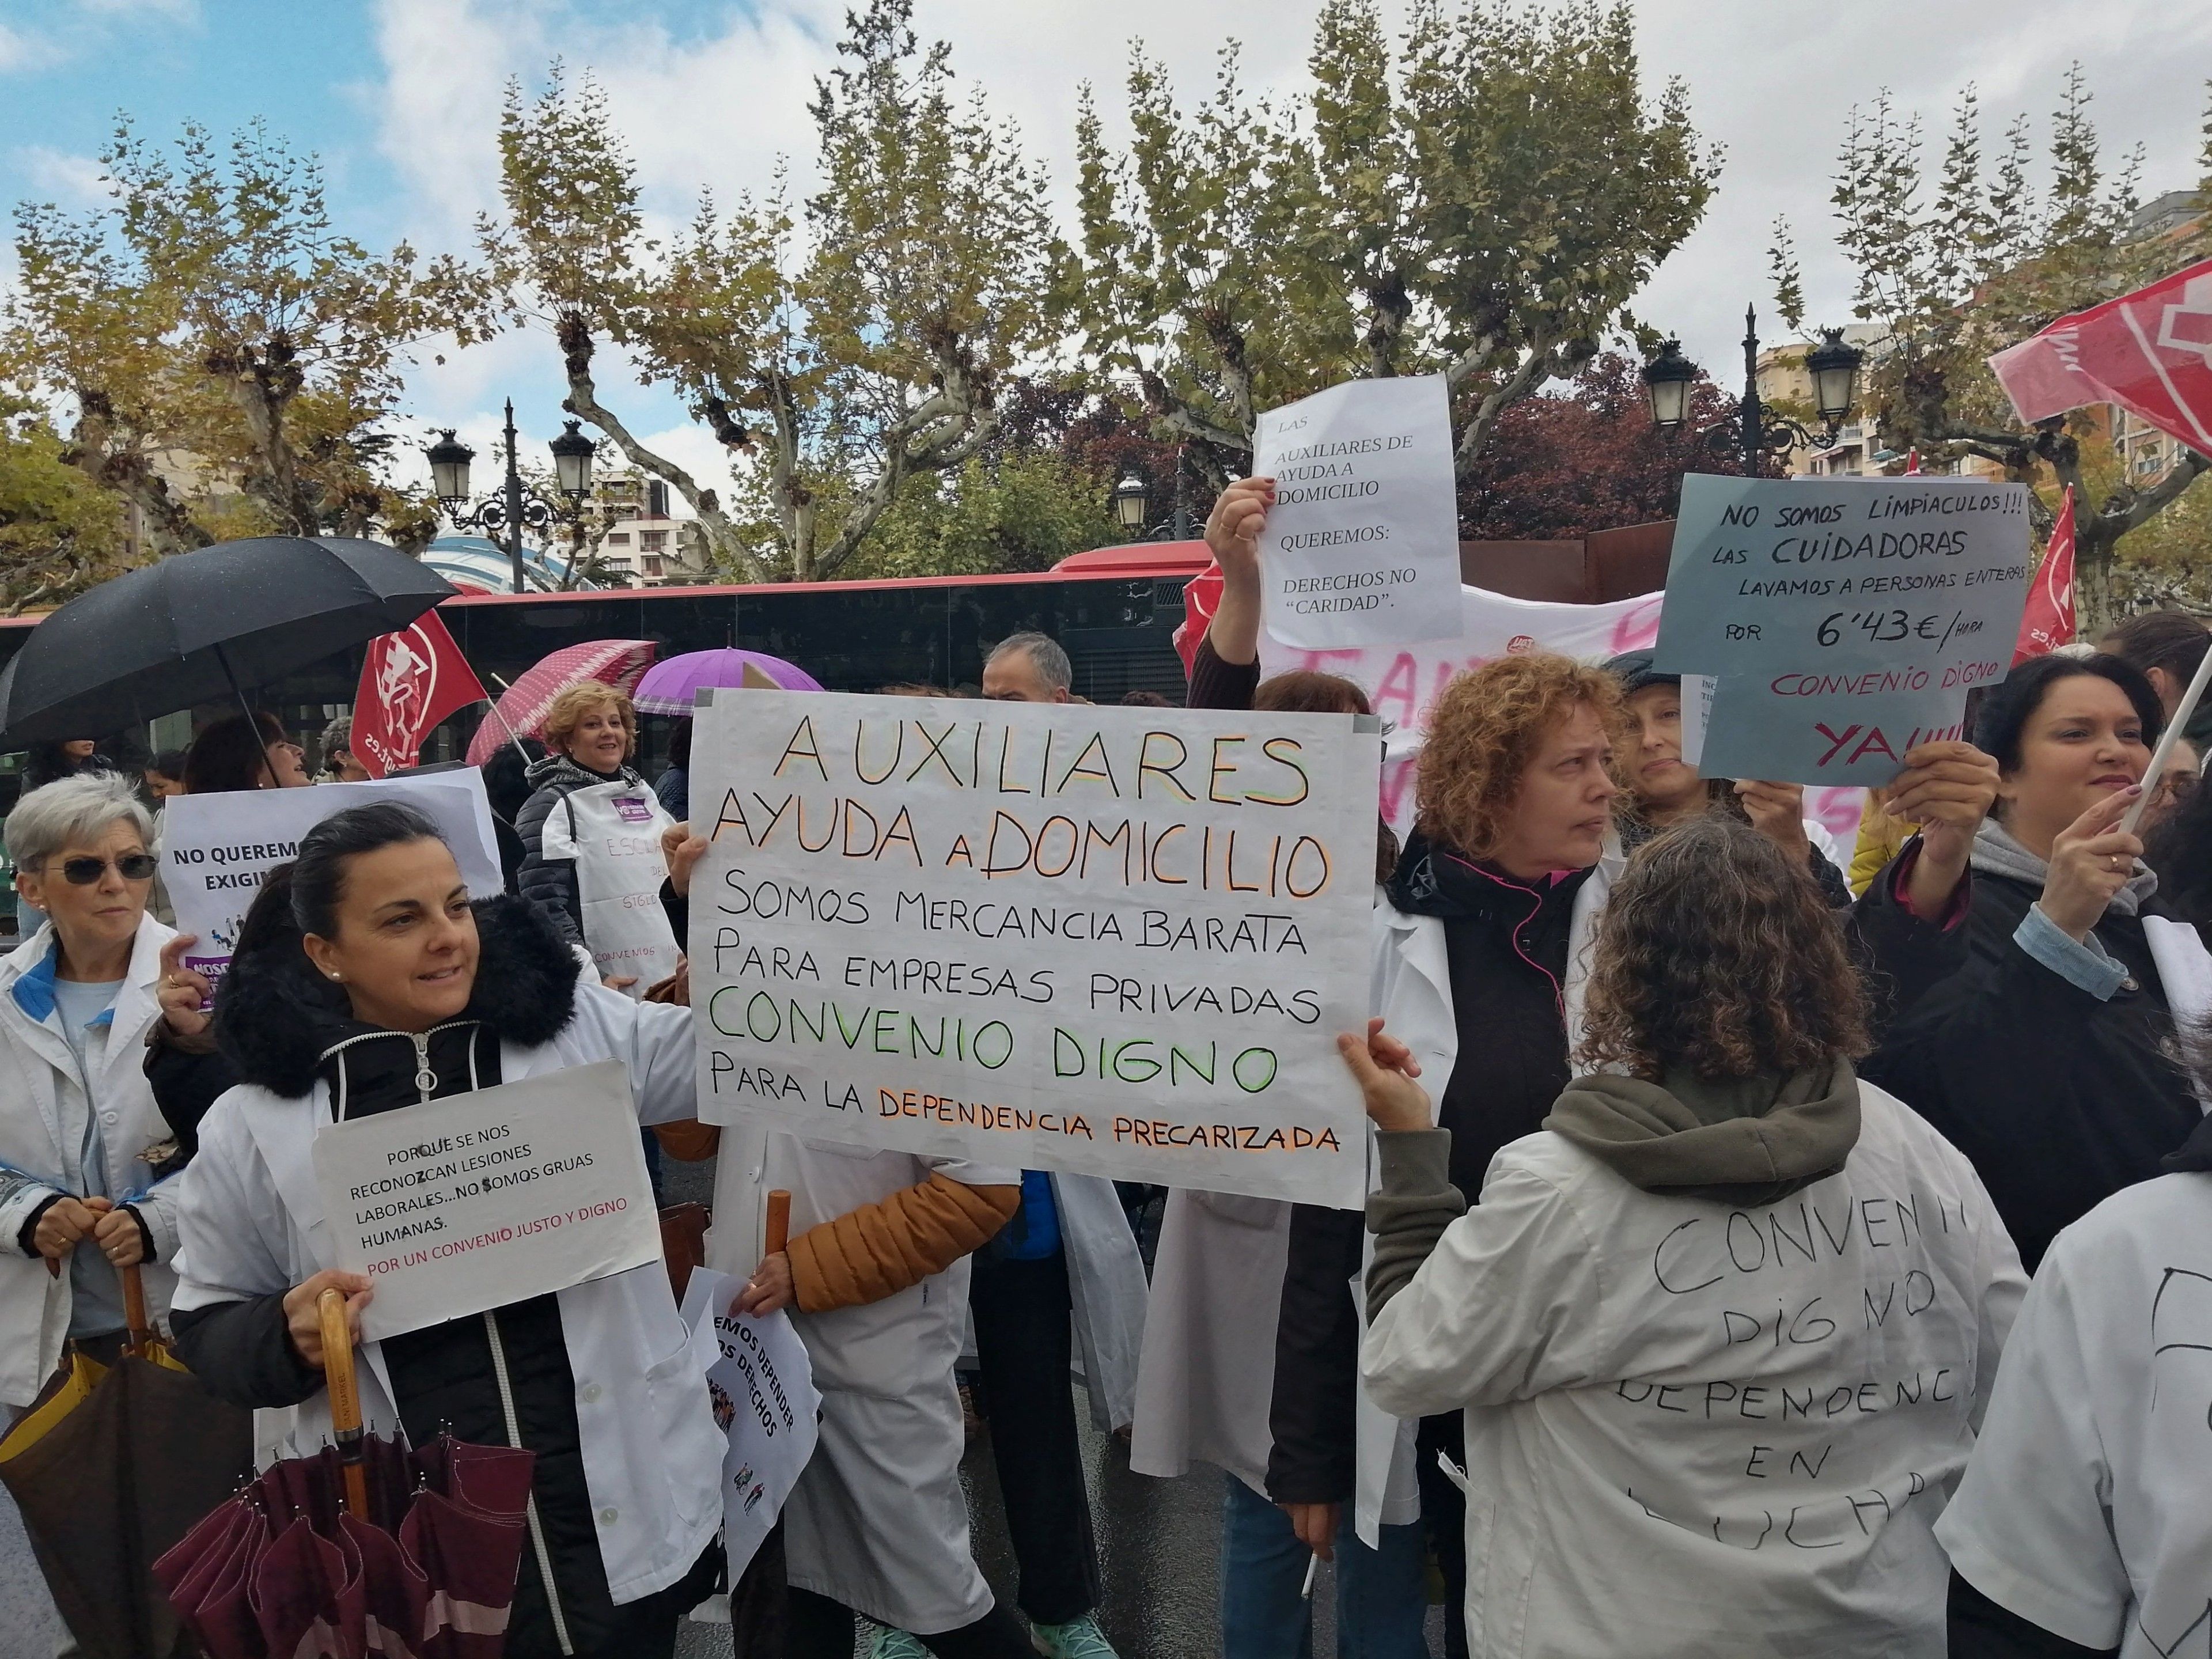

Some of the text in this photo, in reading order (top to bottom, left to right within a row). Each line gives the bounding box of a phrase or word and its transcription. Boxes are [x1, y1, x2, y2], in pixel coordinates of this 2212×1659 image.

[1278, 416, 1308, 434] LAS
[1275, 435, 1413, 464] AUXILIARES DE
[1275, 462, 1354, 483] AYUDA A
[1277, 480, 1379, 506] DOMICILIO
[1720, 504, 1759, 528] NO
[1774, 504, 1846, 528] SOMOS
[1281, 525, 1389, 552] QUEREMOS:
[1712, 547, 1748, 565] LAS
[1282, 568, 1416, 594] DERECHOS NO
[1738, 566, 2025, 597] LAVAMOS A PERSONAS ENTERAS
[1726, 625, 1761, 642] POR
[774, 715, 1309, 805] AUXILIARES
[173, 842, 297, 865] NO QUEREM
[607, 837, 662, 856] ESCLA
[711, 787, 1329, 897] AYUDA A DOMICILIO
[623, 895, 657, 908] SIGLO
[718, 869, 1306, 955] SOMOS MERCANCIA BARATA
[714, 928, 1320, 1024] PARA EMPRESAS PRIVADAS
[709, 986, 1278, 1093] CONVENIO DIGNO
[711, 1052, 1342, 1153] PARA LA DEPENDENCIA PRECARIZADA
[387, 1124, 510, 1165] PORQUE SE NOS
[350, 1144, 532, 1200] RECONOZCAN LESIONES
[482, 1167, 540, 1195] SOMOS
[543, 1153, 594, 1177] GRUAS
[361, 1216, 448, 1249] HUMANAS.
[367, 1197, 627, 1277] POR UN CONVENIO JUSTO Y DIGNO
[714, 1317, 794, 1433] EMOS DEPENDER
[1615, 1362, 1975, 1421] DEPENDENC
[737, 1354, 777, 1437] DERECHOS
[1746, 1445, 1832, 1479] EN
